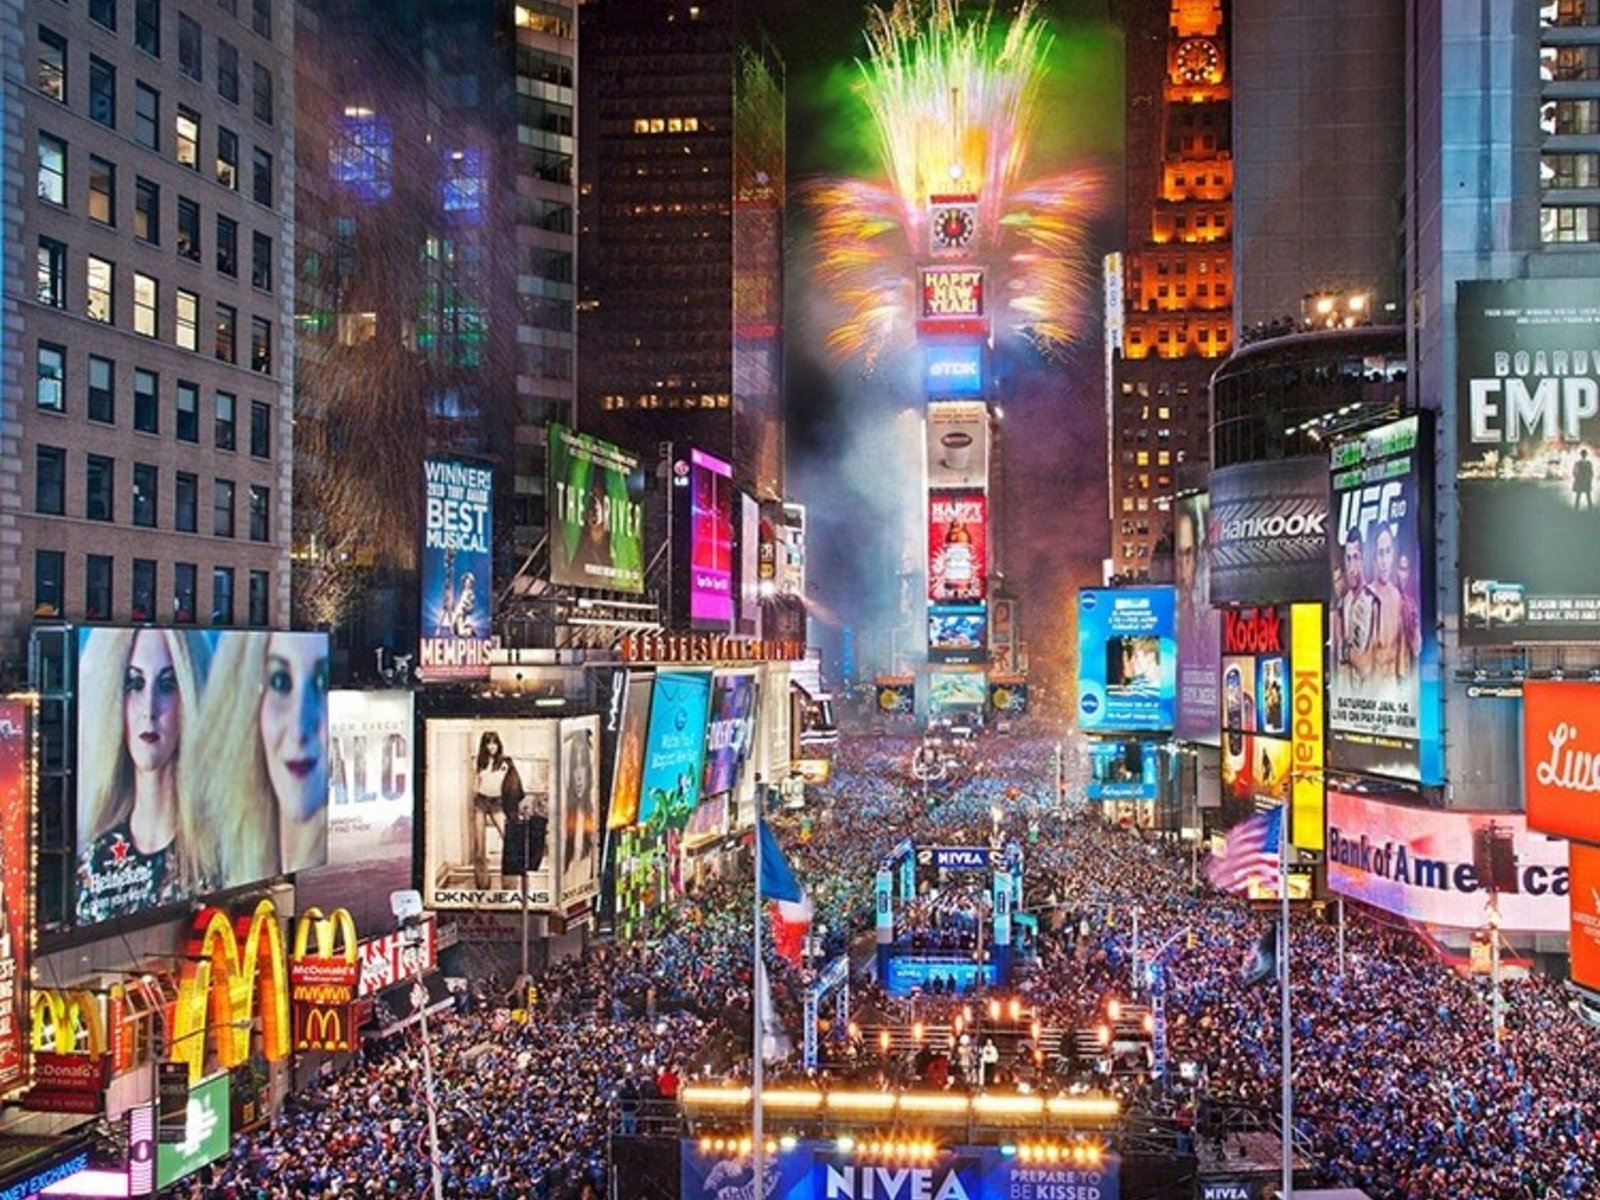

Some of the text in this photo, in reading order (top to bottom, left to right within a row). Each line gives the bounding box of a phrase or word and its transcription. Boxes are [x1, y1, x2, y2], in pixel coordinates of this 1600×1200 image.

[925, 272, 981, 286] HAPPY
[933, 286, 974, 299] NEW
[674, 477, 689, 486] LG
[556, 482, 586, 527] THE
[1338, 481, 1403, 546] UFC
[426, 498, 489, 535] BEST
[426, 529, 488, 553] MUSICAL
[1225, 607, 1281, 652] Kodak
[420, 637, 492, 666] MEMPHIS
[1294, 670, 1320, 785] Kodak
[938, 852, 983, 864] NIVEA
[1329, 827, 1570, 897] Bank of Ameca
[434, 891, 485, 903] DKNY
[293, 965, 355, 974] McDonald's
[36, 1063, 100, 1078] cDonald's
[29, 1153, 89, 1194] EXCHANGE
[826, 1163, 970, 1200] NIVEA
[1011, 1169, 1101, 1184] PREPARE TO
[1010, 1184, 1100, 1200] BE KISSED
[1204, 1188, 1249, 1200] NIVEA
